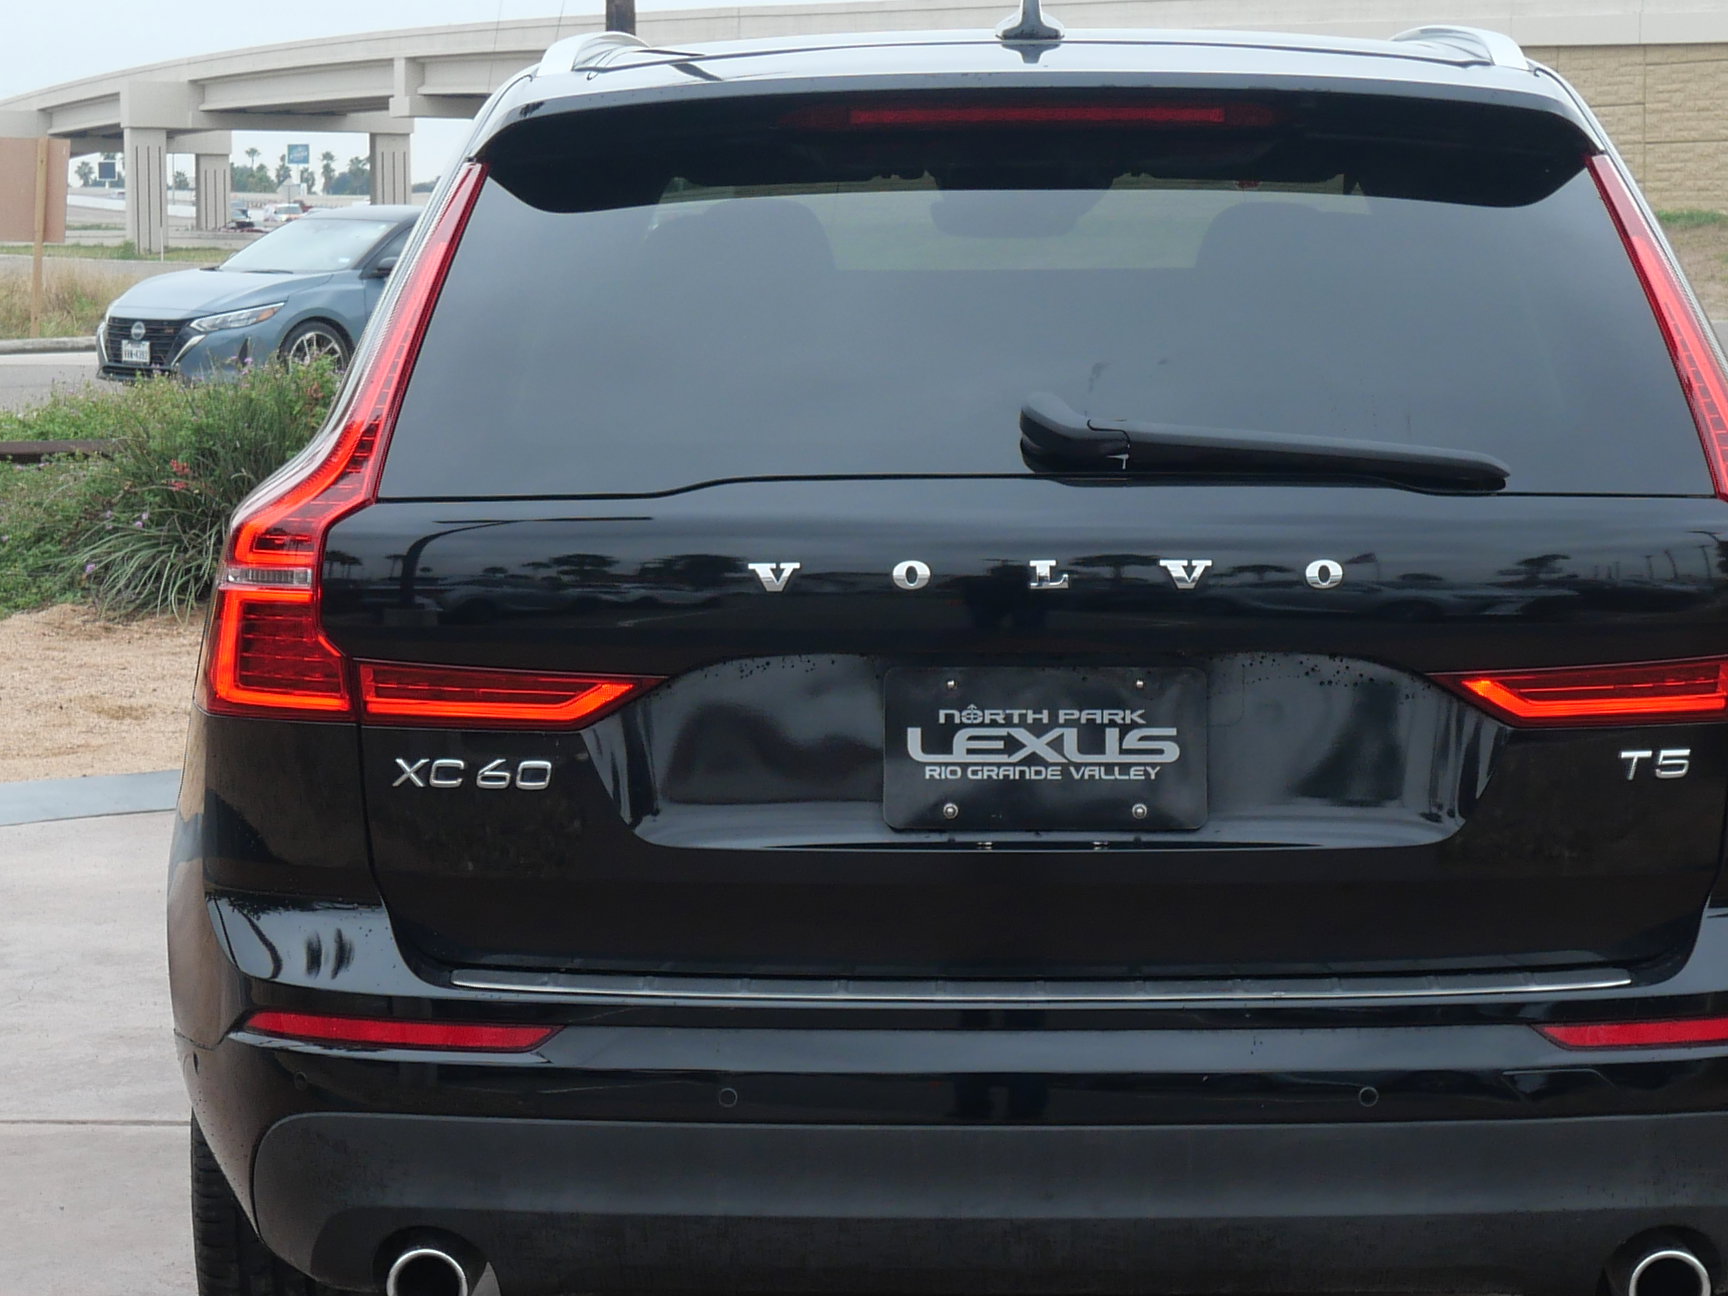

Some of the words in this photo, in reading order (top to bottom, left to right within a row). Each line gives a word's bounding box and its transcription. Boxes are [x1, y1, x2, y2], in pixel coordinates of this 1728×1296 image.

[748, 559, 1343, 592] VOLVO
[1058, 709, 1146, 724] PARK
[907, 727, 1180, 763] LEXUS
[392, 758, 553, 790] XC60
[925, 766, 962, 780] RIO
[967, 766, 1062, 780] GRANDE
[1069, 766, 1161, 780] VALLEY
[1619, 748, 1692, 781] T5
